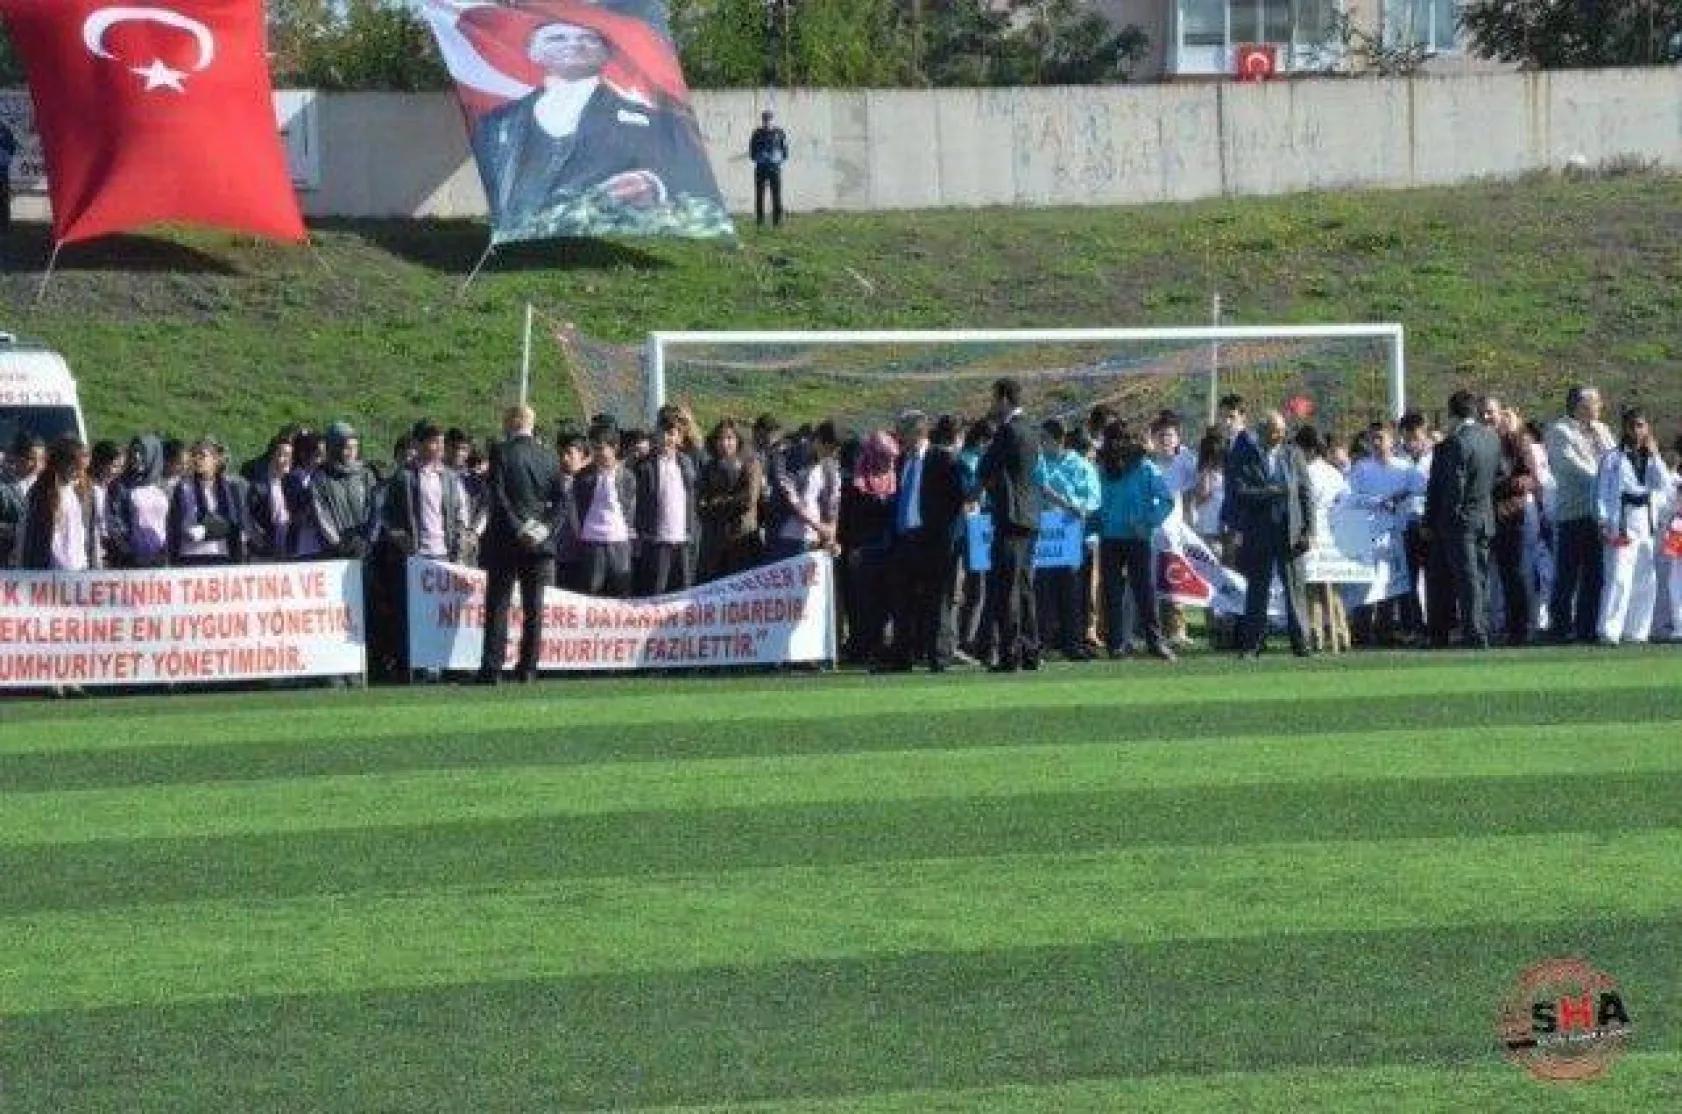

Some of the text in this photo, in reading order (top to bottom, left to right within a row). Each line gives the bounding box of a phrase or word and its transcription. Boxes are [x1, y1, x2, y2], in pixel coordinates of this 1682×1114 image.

[31, 574, 172, 607] MİLLETİNİN
[299, 571, 326, 599] VE
[132, 616, 162, 642] EN
[170, 611, 249, 641] UYGUN
